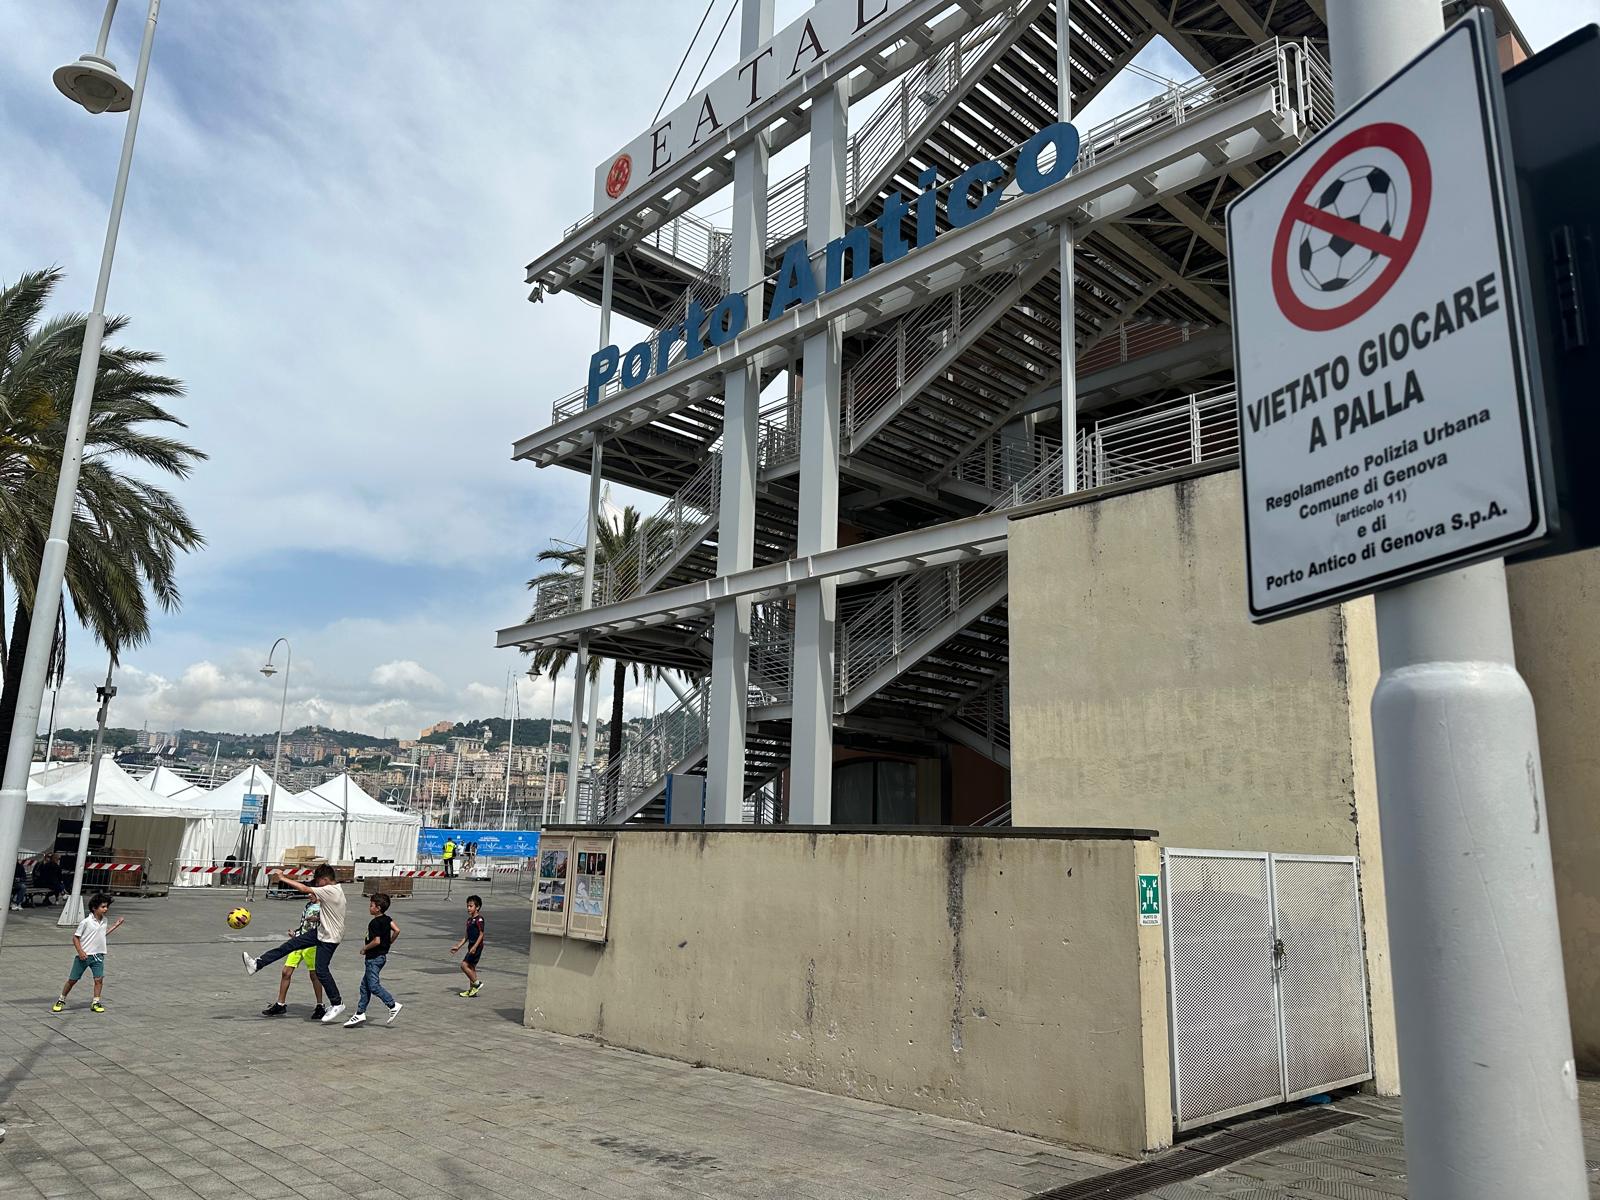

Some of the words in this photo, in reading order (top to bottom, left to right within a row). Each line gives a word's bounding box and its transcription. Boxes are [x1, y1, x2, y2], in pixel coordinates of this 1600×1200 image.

[587, 293, 748, 405] Porto
[769, 121, 1080, 321] Antico
[1247, 355, 1350, 433] VIETATO
[1358, 272, 1499, 377] GIOCARE
[1309, 416, 1327, 453] A
[1333, 369, 1424, 441] PALLA
[1266, 463, 1359, 512] Regolamento
[1364, 438, 1418, 471] Polizia
[1423, 408, 1491, 446] Urbana
[1299, 487, 1359, 519] Comune
[1364, 477, 1378, 495] di
[1383, 452, 1448, 487] Genova
[1266, 566, 1304, 590] Porto
[1308, 553, 1356, 578] Antico
[1362, 542, 1376, 560] di
[1381, 522, 1446, 554] Genova
[1451, 500, 1508, 531] S.p.A.
[1336, 498, 1384, 527] (articolo
[1388, 488, 1407, 504] 11)
[1357, 524, 1366, 538] e
[1372, 515, 1387, 533] di
